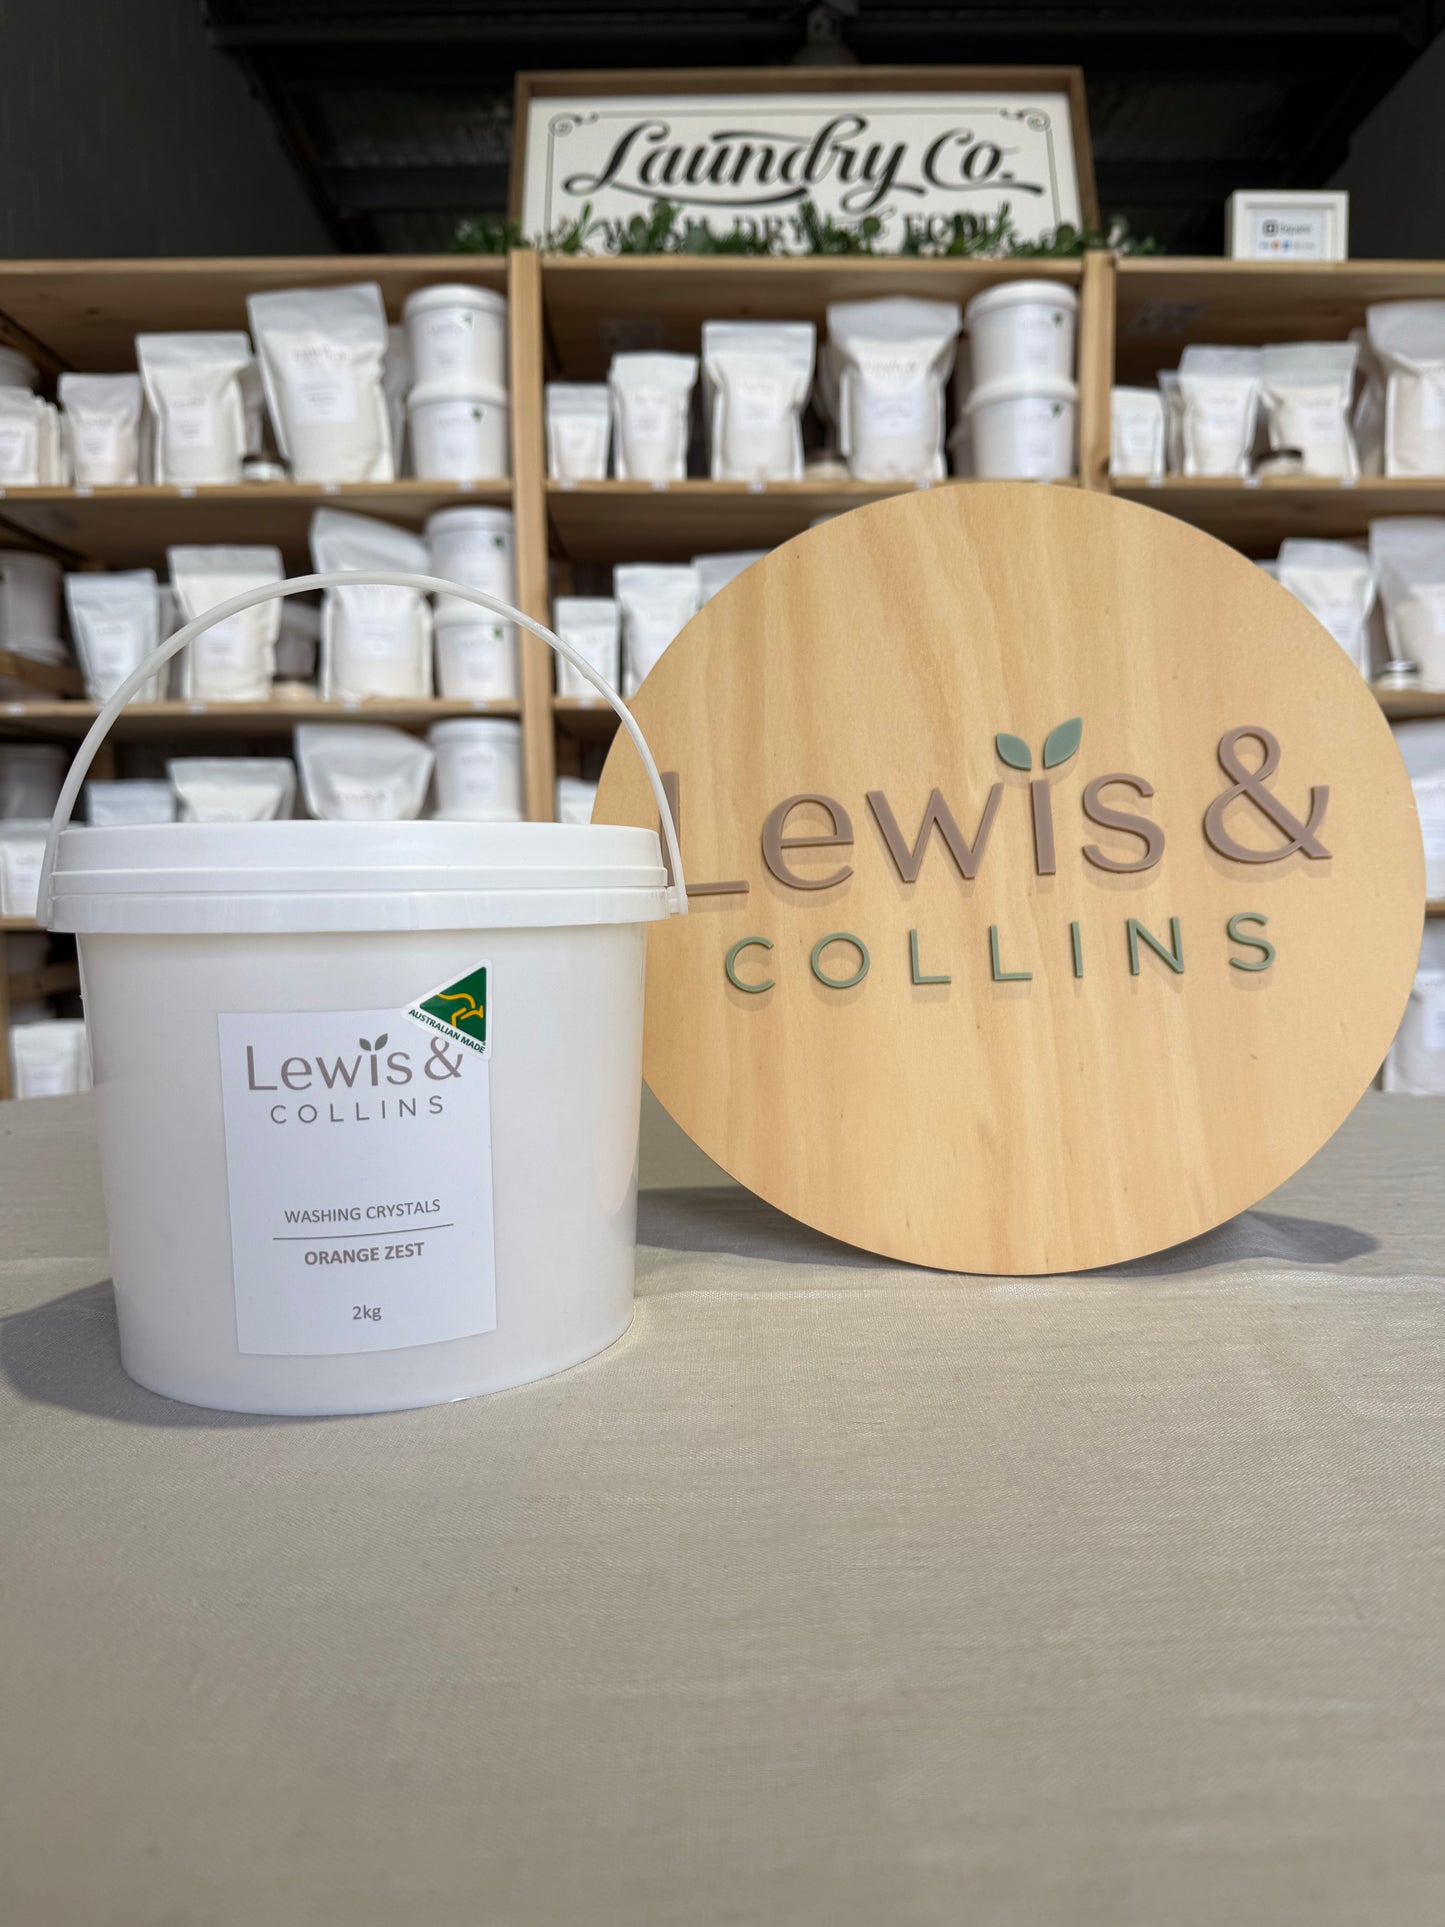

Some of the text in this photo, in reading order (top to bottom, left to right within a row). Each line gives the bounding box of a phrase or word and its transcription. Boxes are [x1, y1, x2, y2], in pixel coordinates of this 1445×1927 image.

[562, 113, 1044, 215] Laundry Co.
[659, 716, 1333, 897] Lewis &
[724, 911, 1277, 993] COLLINS
[408, 1009, 486, 1054] AUSTRALIAN MADE
[246, 1033, 463, 1091] Lewis &
[270, 1095, 444, 1124] COLLINS
[284, 1199, 441, 1224] WASHING CRYSTALS
[304, 1242, 425, 1266] ORANGE ZEST
[352, 1305, 382, 1322] 2kg
